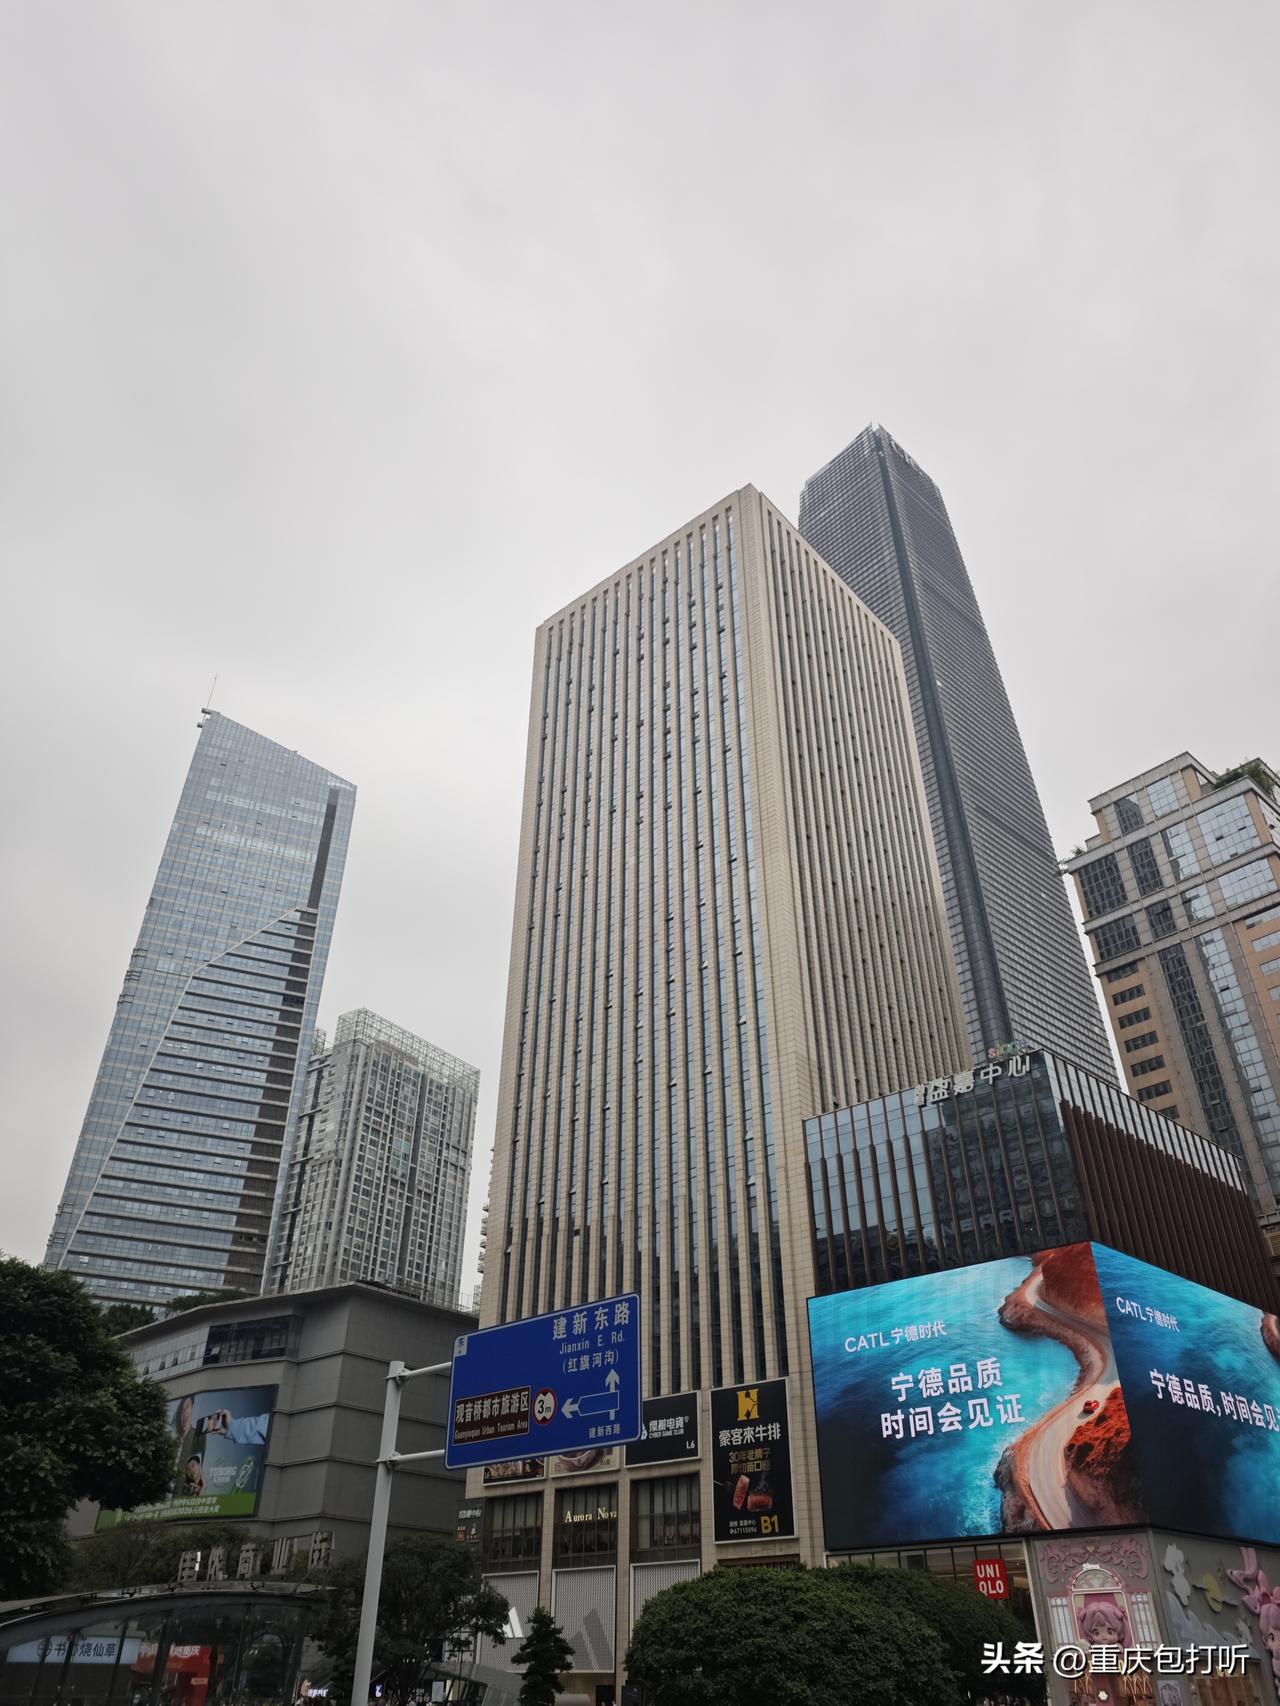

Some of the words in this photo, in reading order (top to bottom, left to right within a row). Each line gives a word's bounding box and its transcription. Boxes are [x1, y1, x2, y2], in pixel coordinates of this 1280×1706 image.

[553, 1301, 631, 1340] 建新东路
[1116, 1296, 1147, 1321] CATL
[1145, 1306, 1180, 1333] 宁德时代
[560, 1338, 589, 1355] Jianxin
[597, 1335, 605, 1347] E.
[611, 1331, 625, 1344] Rd.
[844, 1332, 890, 1353] CATL
[891, 1320, 947, 1345] 宁德时代
[891, 1356, 1003, 1402] 宁德品质
[456, 1391, 529, 1423] 观音桥都市旅游区
[1149, 1368, 1280, 1432] 宁德品质，时间会见
[880, 1393, 1025, 1439] 时间会见证
[589, 1423, 621, 1439] 建新西路
[719, 1422, 781, 1447] 豪客來牛排
[686, 1440, 695, 1450] L6
[210, 1466, 237, 1476] TUBORG
[564, 1510, 592, 1523] Aurora
[760, 1514, 779, 1534] B1
[976, 1564, 1000, 1578] UNI
[979, 1580, 1004, 1597] QLO
